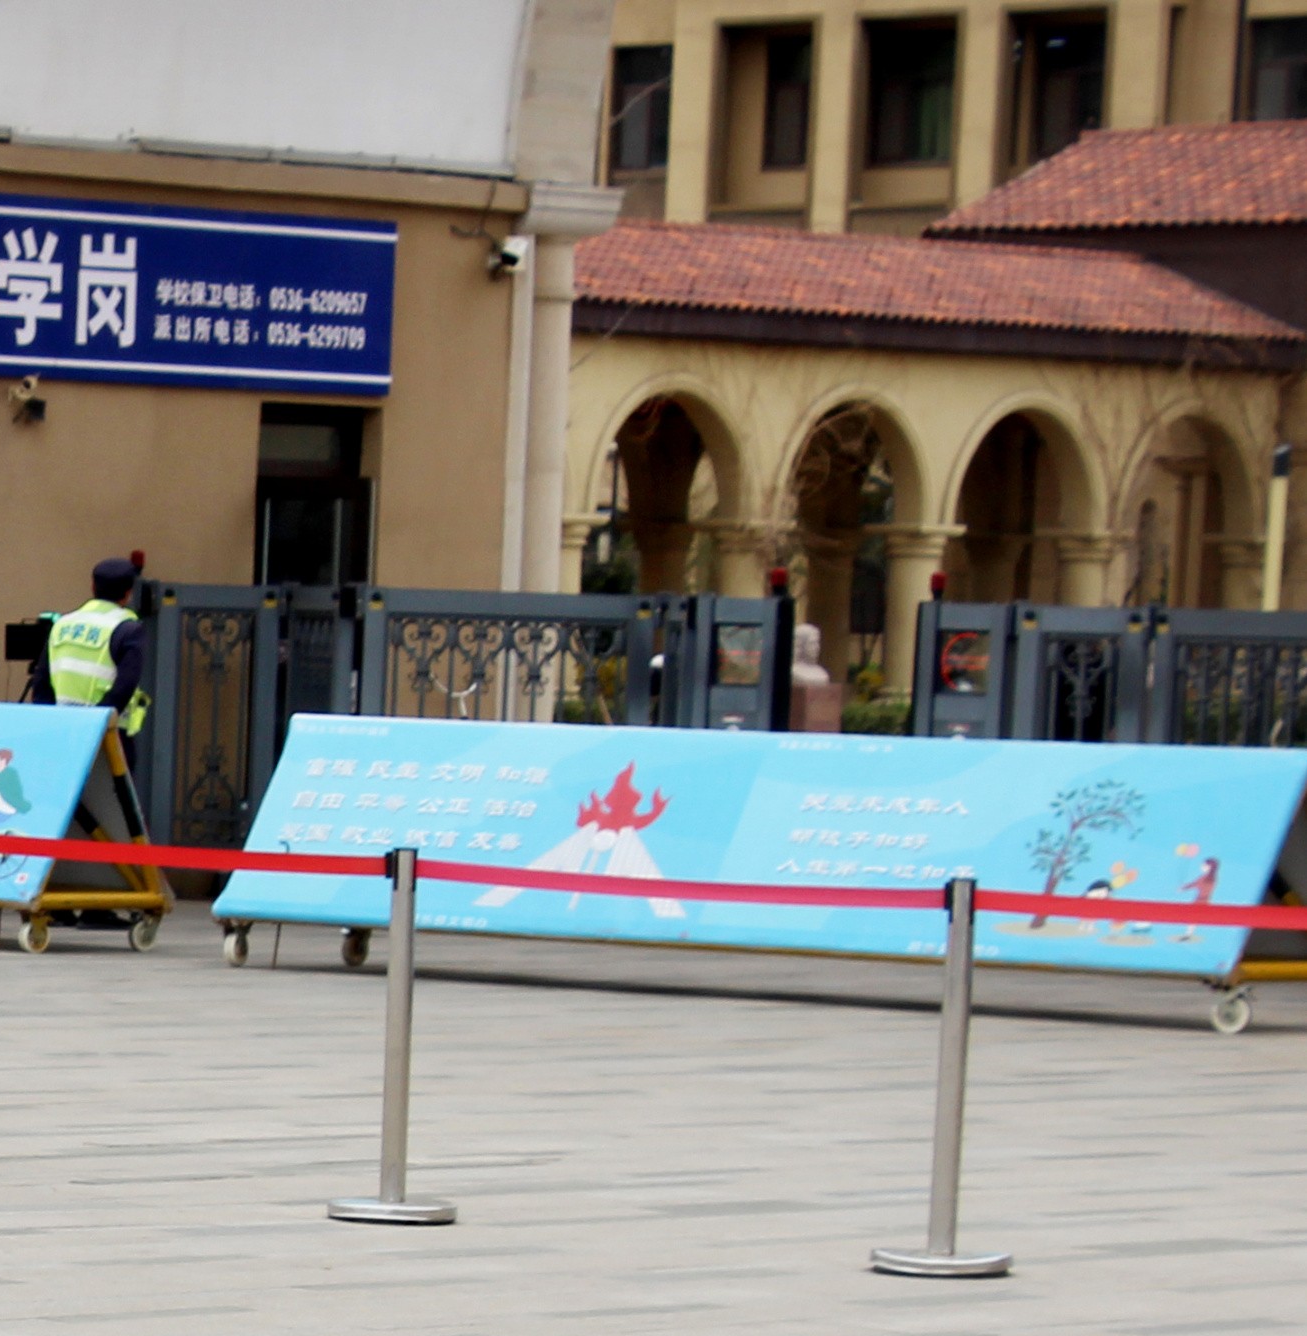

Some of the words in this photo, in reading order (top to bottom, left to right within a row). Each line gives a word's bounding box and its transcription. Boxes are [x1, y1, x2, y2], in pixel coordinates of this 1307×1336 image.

[306, 757, 359, 778] 富强
[366, 760, 421, 780] 民主
[430, 763, 486, 783] 文明
[496, 765, 550, 785] 和谐
[292, 790, 346, 810] 自由
[354, 793, 408, 813] 平等
[417, 796, 473, 814] 公正
[486, 799, 537, 818] 法治
[278, 822, 334, 842] 爱国
[340, 825, 394, 846] 敬业
[404, 828, 460, 849] 诚信
[468, 831, 522, 851] 友善
